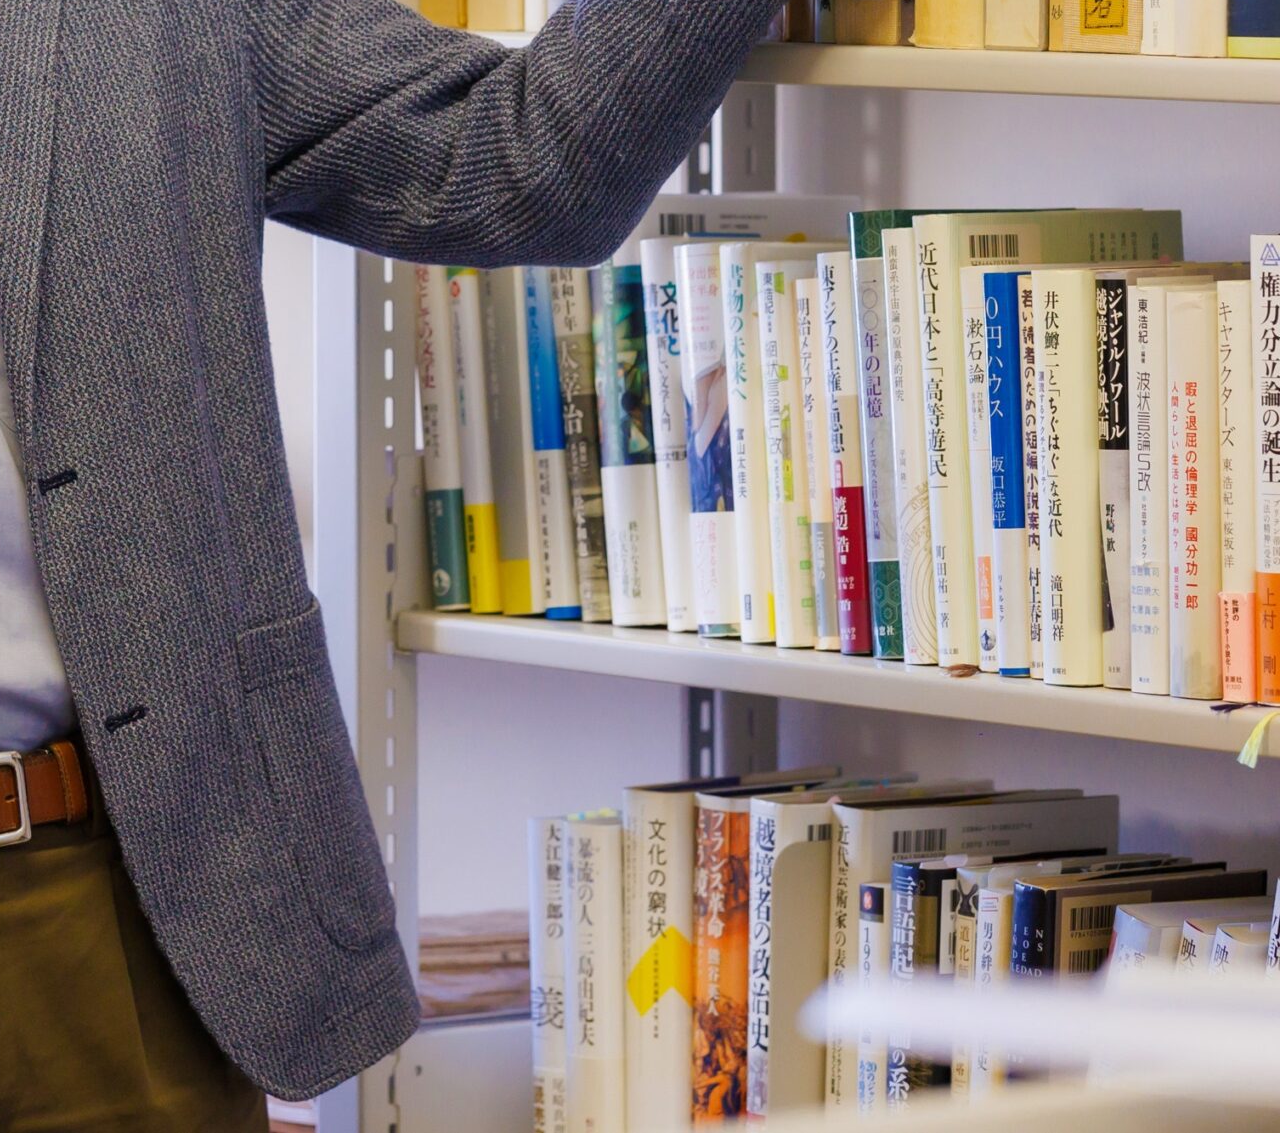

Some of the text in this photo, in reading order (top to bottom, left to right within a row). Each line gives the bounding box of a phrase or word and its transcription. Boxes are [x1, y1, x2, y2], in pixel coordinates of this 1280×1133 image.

[659, 280, 681, 357] 文化と
[728, 263, 748, 401] 書物の未来へ
[797, 297, 815, 413] 明治メディア考
[823, 264, 846, 454] 東アジアの王権と思想
[861, 278, 884, 419] 一〇〇年の記憶
[918, 241, 950, 489] 近代日本と「高等遊民」
[965, 316, 985, 385] 漱石論
[1107, 287, 1127, 441] ジャン・ルノワール
[1137, 298, 1149, 344] 東浩紀
[1218, 302, 1237, 447] キャラクターズ
[1020, 288, 1041, 552] 若い読者のための短編小説案内
[1044, 290, 1064, 538] 井伏鱒二と「ちぐはぐ」な近代
[1259, 271, 1280, 483] 権力分立論の誕生
[734, 427, 748, 499] 富山太佳夫
[991, 455, 1007, 528] 坂口恭平
[1184, 381, 1199, 516] 暇と退屈の倫理学
[834, 495, 849, 531] 渡辺
[1105, 503, 1116, 534] 野崎
[1184, 526, 1199, 610] 國分功一郎
[934, 544, 949, 604] 町田祐一
[1028, 566, 1042, 643] 村上春樹
[1050, 574, 1065, 642] 滝口明祥
[1262, 587, 1277, 631] 上村
[545, 824, 564, 939] 大江健三郎の
[647, 819, 669, 939] 文化の窮状
[752, 817, 777, 1053] 越境者の政治史
